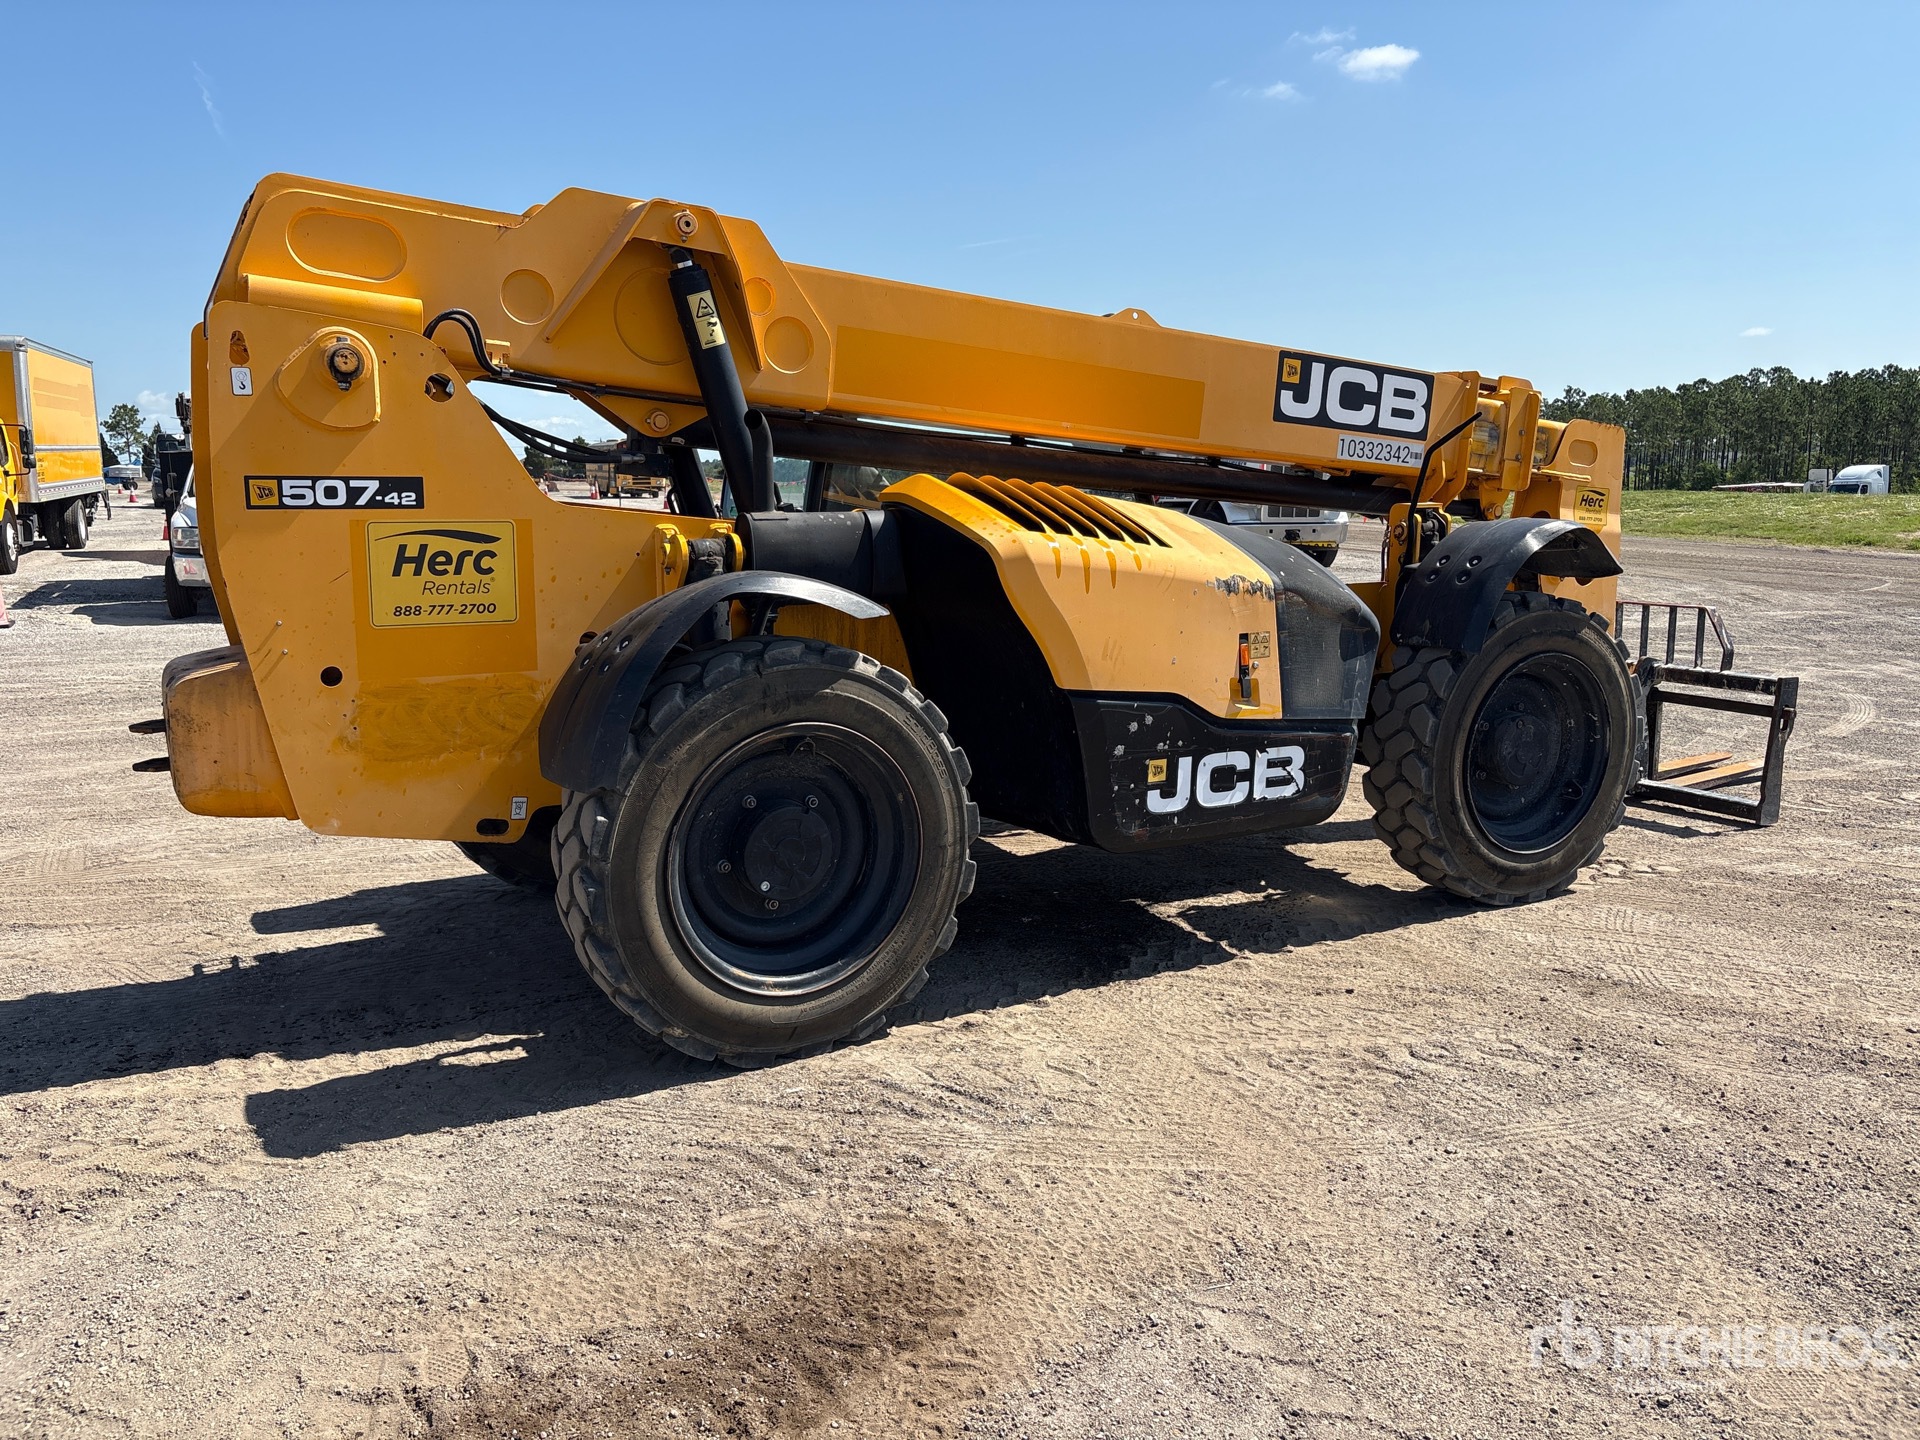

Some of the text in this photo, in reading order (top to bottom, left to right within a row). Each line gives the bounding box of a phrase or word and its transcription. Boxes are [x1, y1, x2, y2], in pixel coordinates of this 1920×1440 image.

[1280, 362, 1428, 433] JCB
[1340, 438, 1410, 463] 10332342
[255, 479, 417, 506] JCB 507-42
[1580, 494, 1605, 508] Herc
[391, 543, 498, 577] Herc
[393, 603, 497, 617] 888-777-2700
[1147, 745, 1305, 813] JCB
